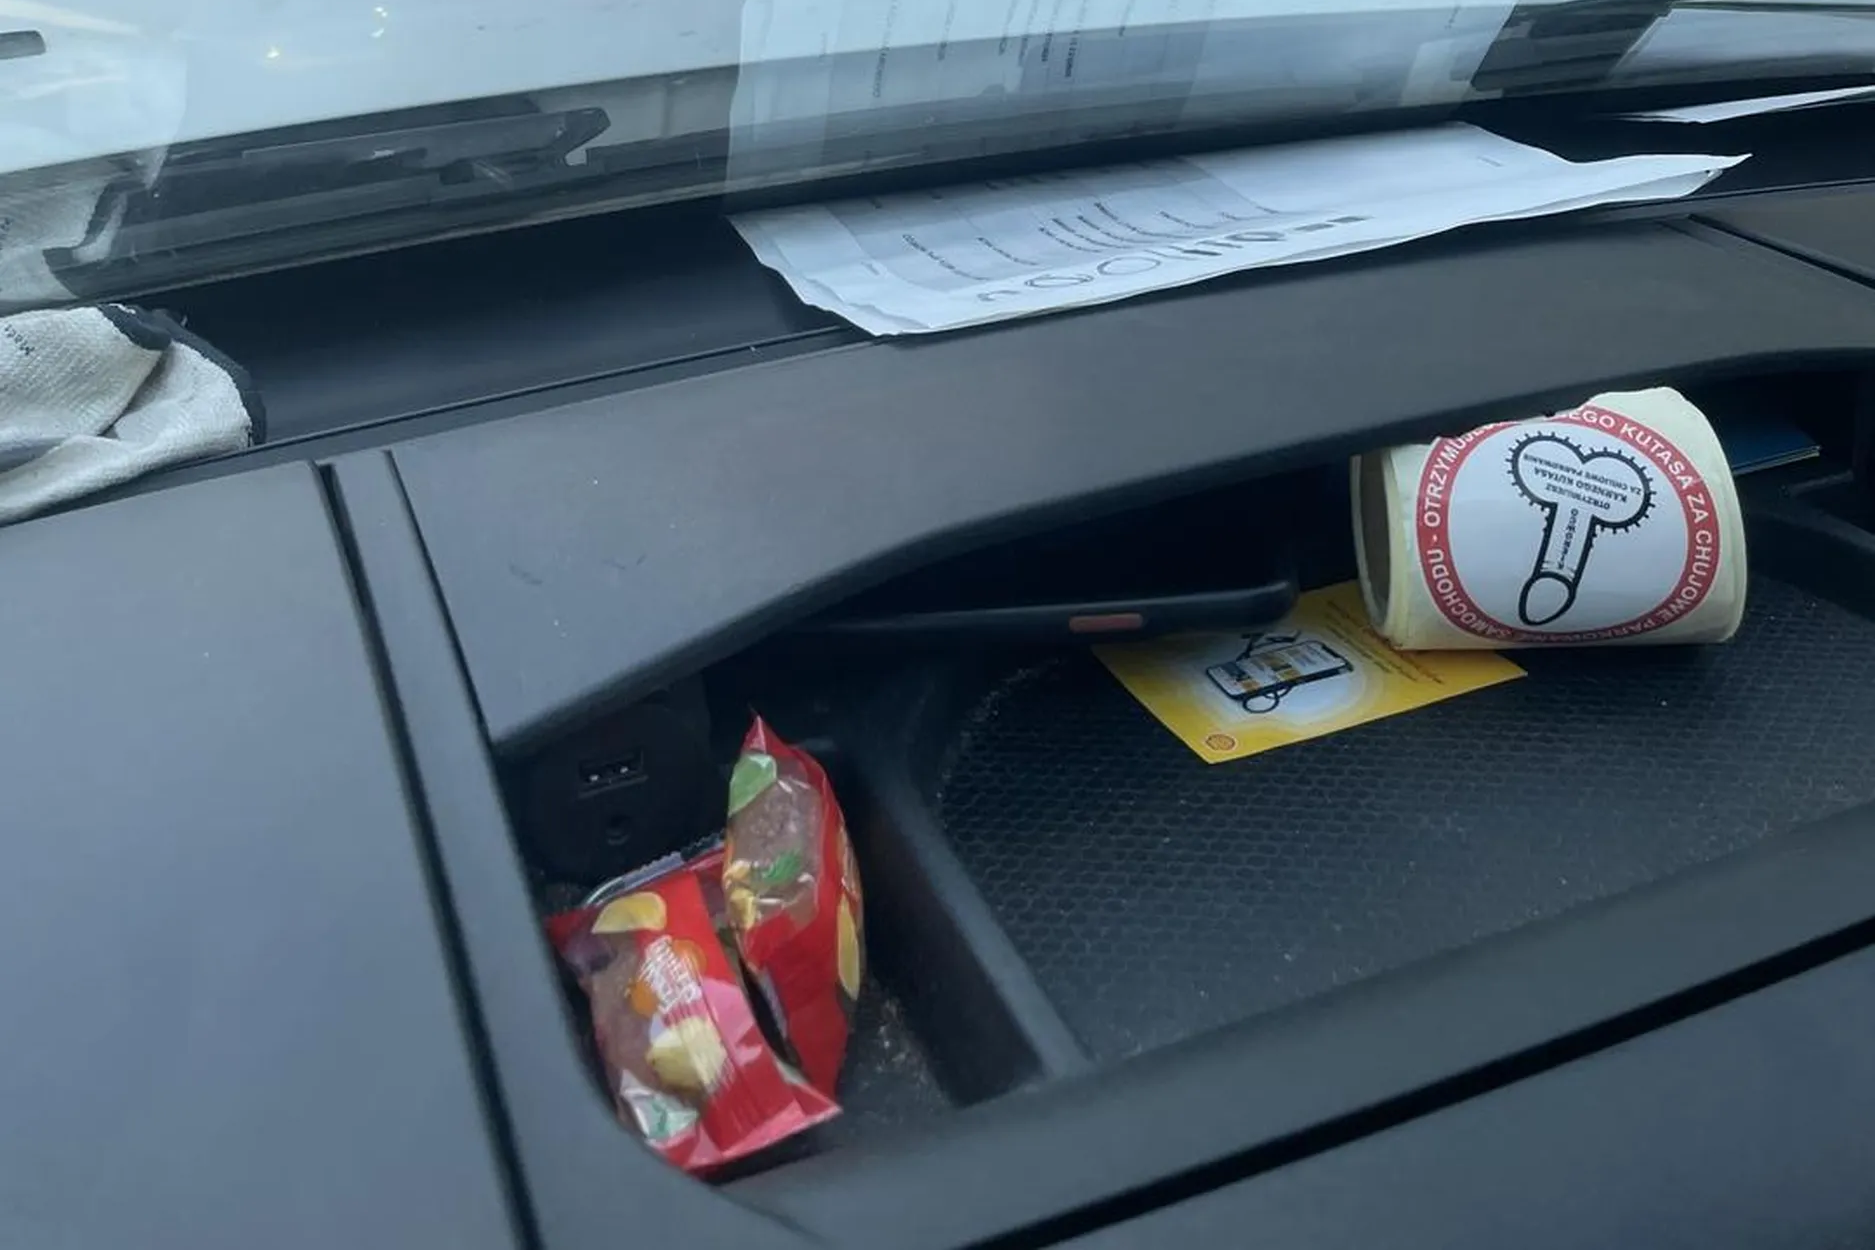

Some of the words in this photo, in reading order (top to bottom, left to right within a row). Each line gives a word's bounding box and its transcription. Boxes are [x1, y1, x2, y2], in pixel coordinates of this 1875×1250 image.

[1620, 423, 1694, 490] KUTASA
[1686, 493, 1709, 524] ZA
[1426, 548, 1514, 638] SAMOCHODU
[1655, 530, 1712, 622] CHUJOWE
